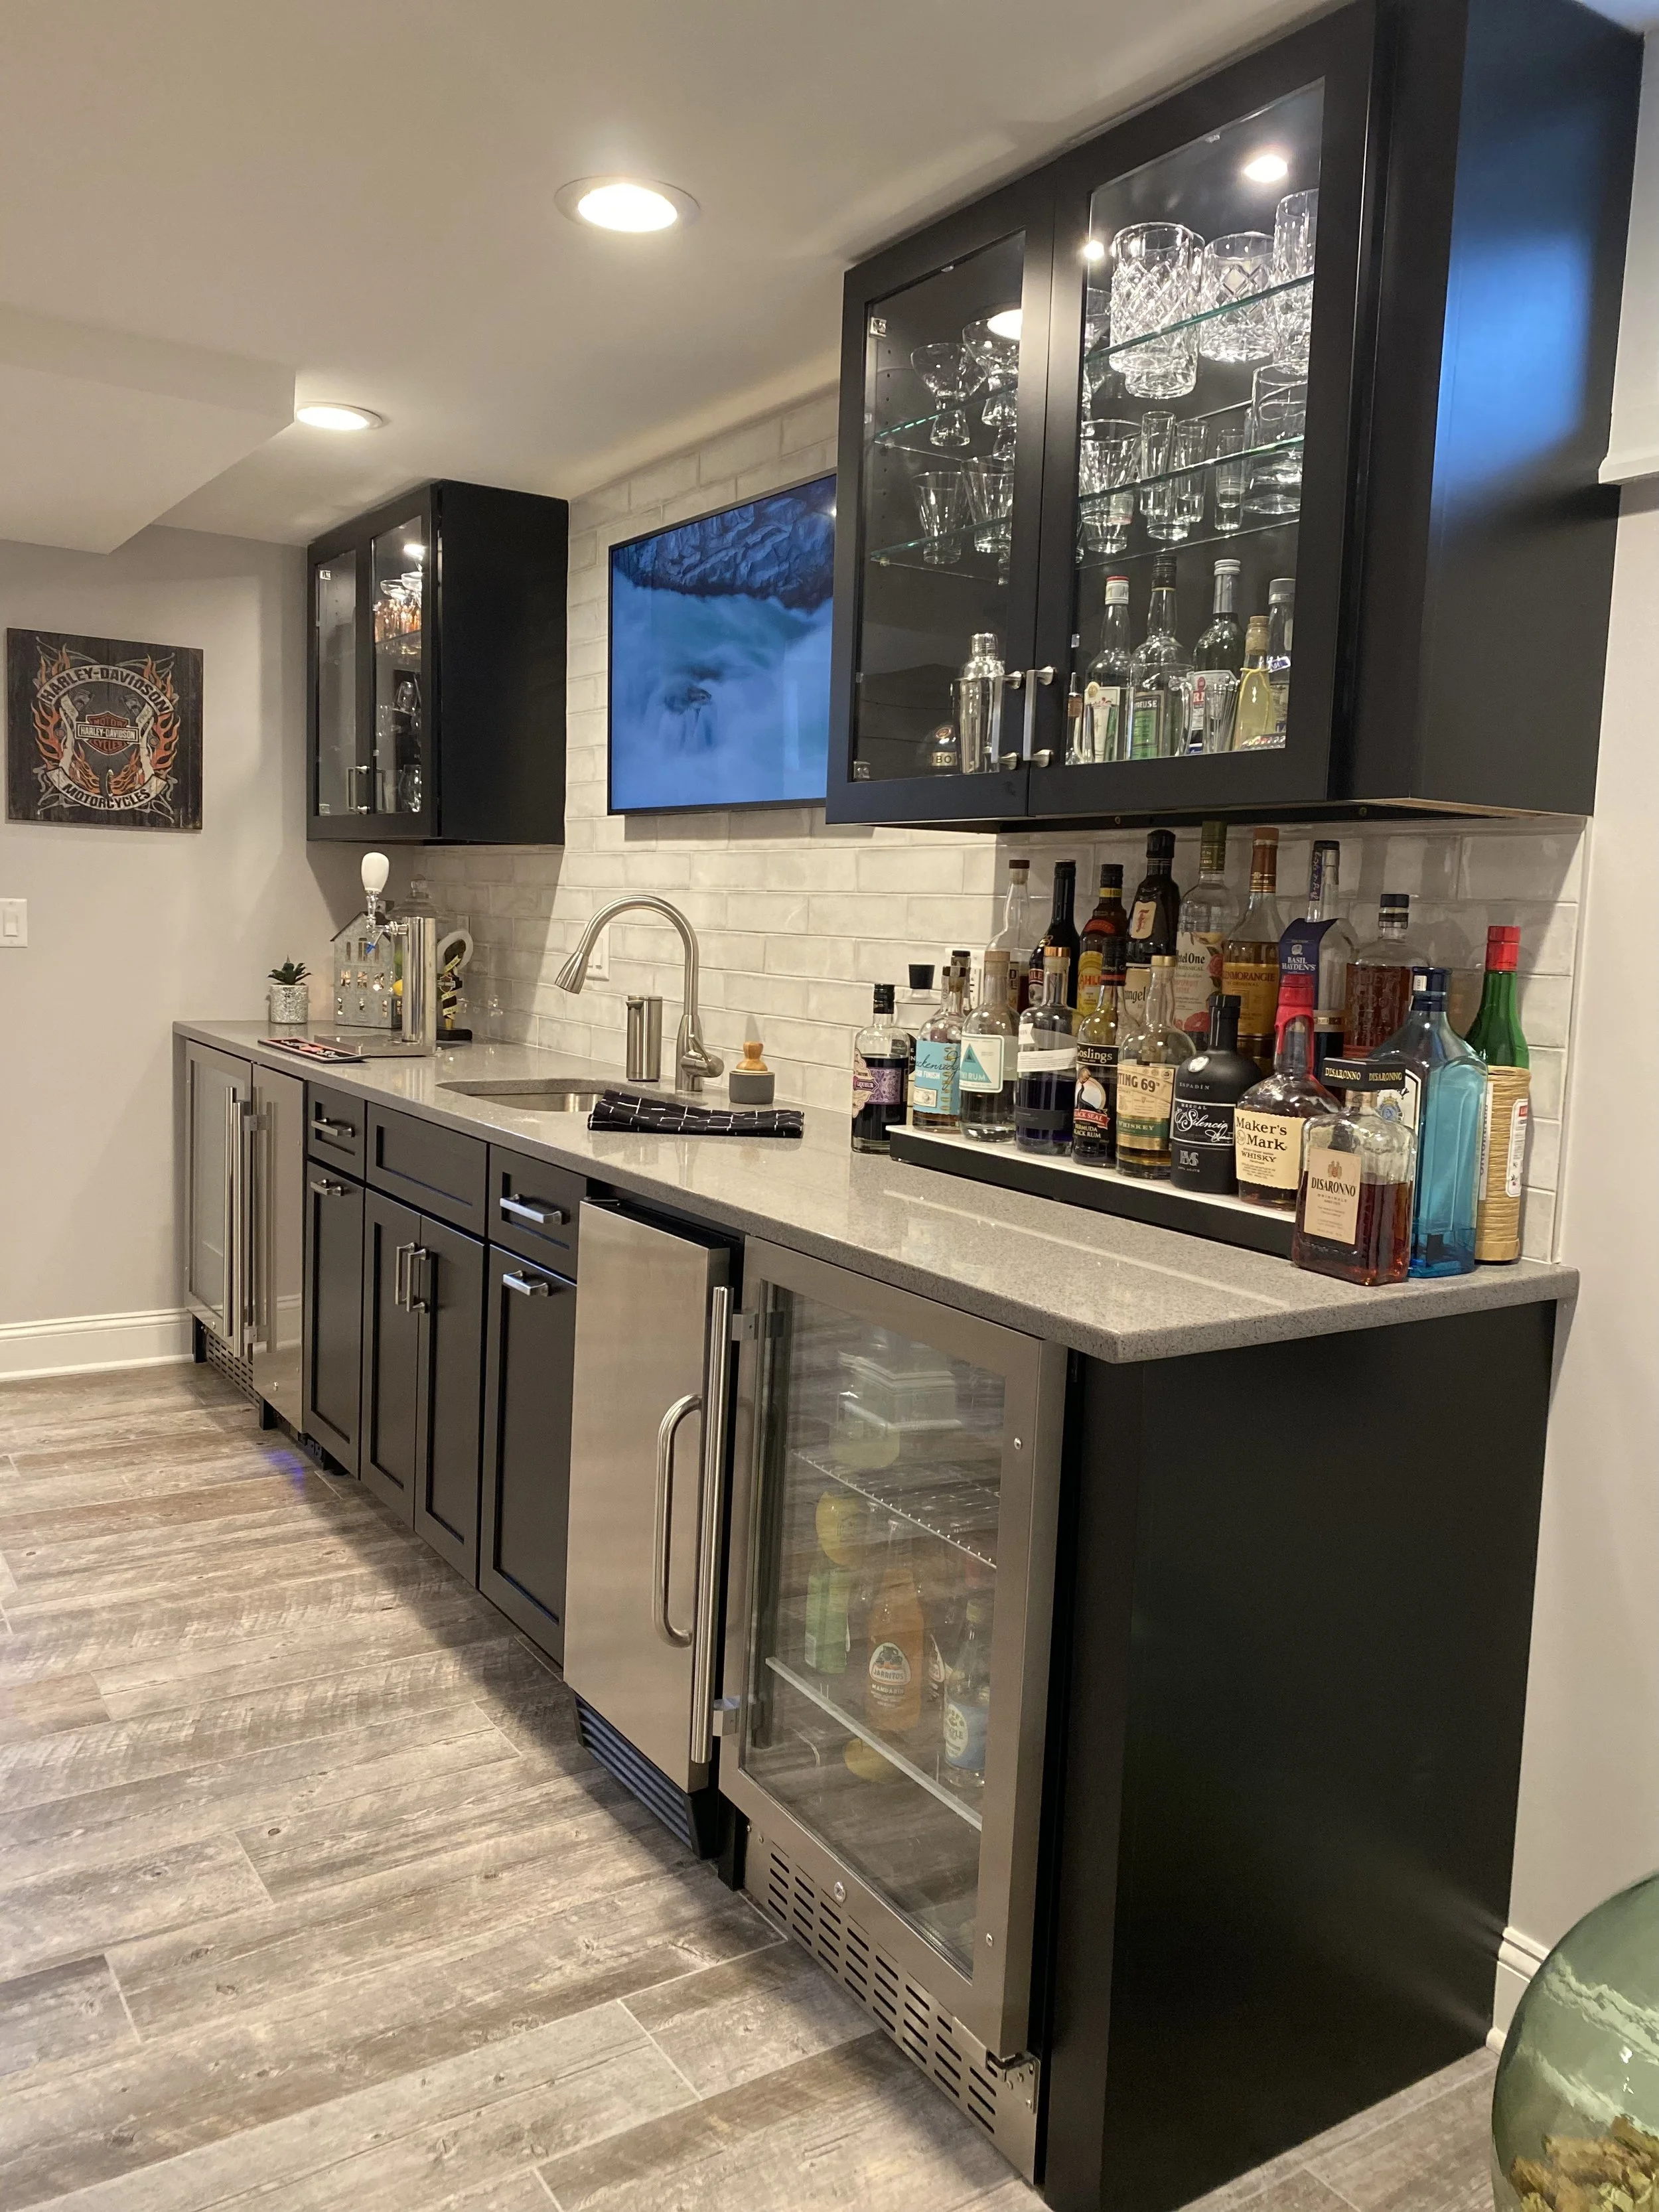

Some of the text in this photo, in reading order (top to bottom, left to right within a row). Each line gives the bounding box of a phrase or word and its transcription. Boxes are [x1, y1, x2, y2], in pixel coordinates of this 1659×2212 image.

[40, 667, 169, 713] HARLEY-DAVIDSON
[92, 718, 127, 727] MOTOR
[80, 726, 135, 739] HARLEY-DAVIDSON
[91, 739, 124, 749] CYCLES
[62, 782, 150, 809] MOTORCYCLES
[1189, 952, 1205, 964] One
[1325, 1067, 1361, 1081] DISARONNO
[1368, 1072, 1403, 1081] DISARONNO
[1118, 1120, 1154, 1131] WHISKEY
[1236, 1116, 1287, 1136] Maker's
[1246, 1134, 1286, 1151] Mark
[1241, 1150, 1277, 1163] WHISKY
[1311, 1177, 1356, 1197] DISARONNO
[873, 1668, 904, 1680] JARRITOS
